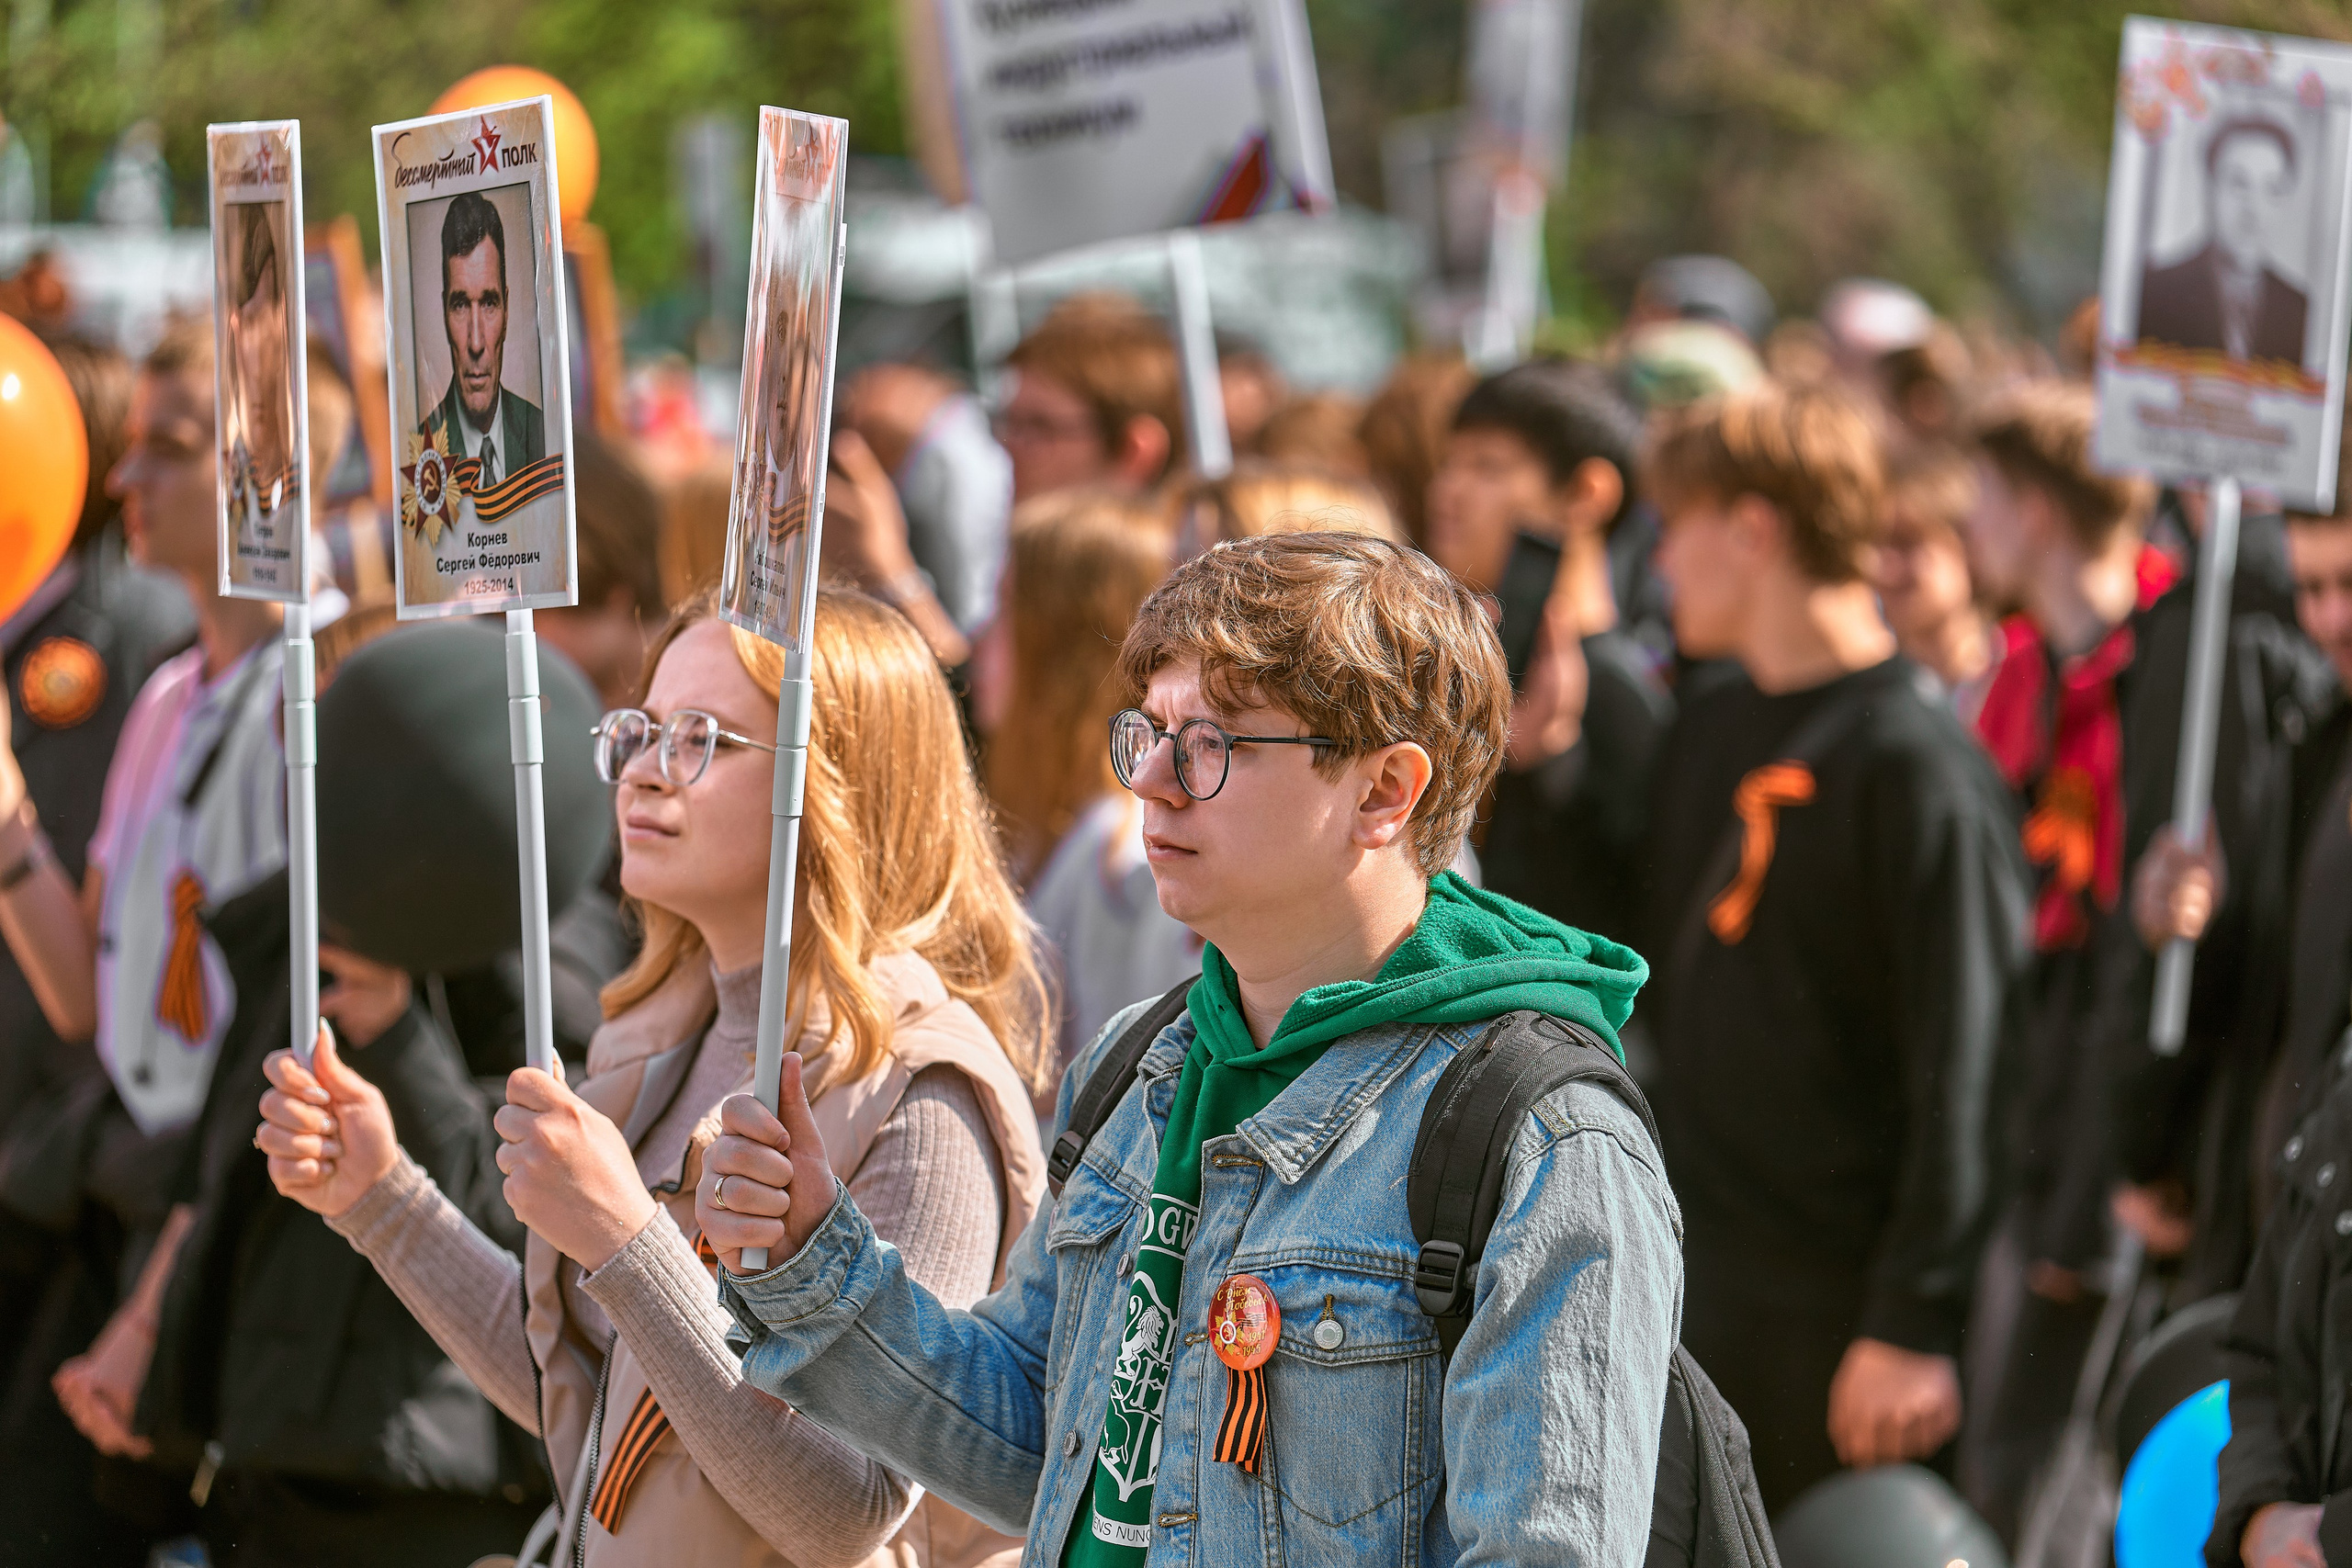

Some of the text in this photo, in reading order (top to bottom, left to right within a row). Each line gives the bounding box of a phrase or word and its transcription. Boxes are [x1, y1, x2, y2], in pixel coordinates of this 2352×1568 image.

[468, 533, 507, 549] Корнев
[436, 551, 540, 575] Сергей Фёдорович
[464, 578, 514, 595] 1925-2014
